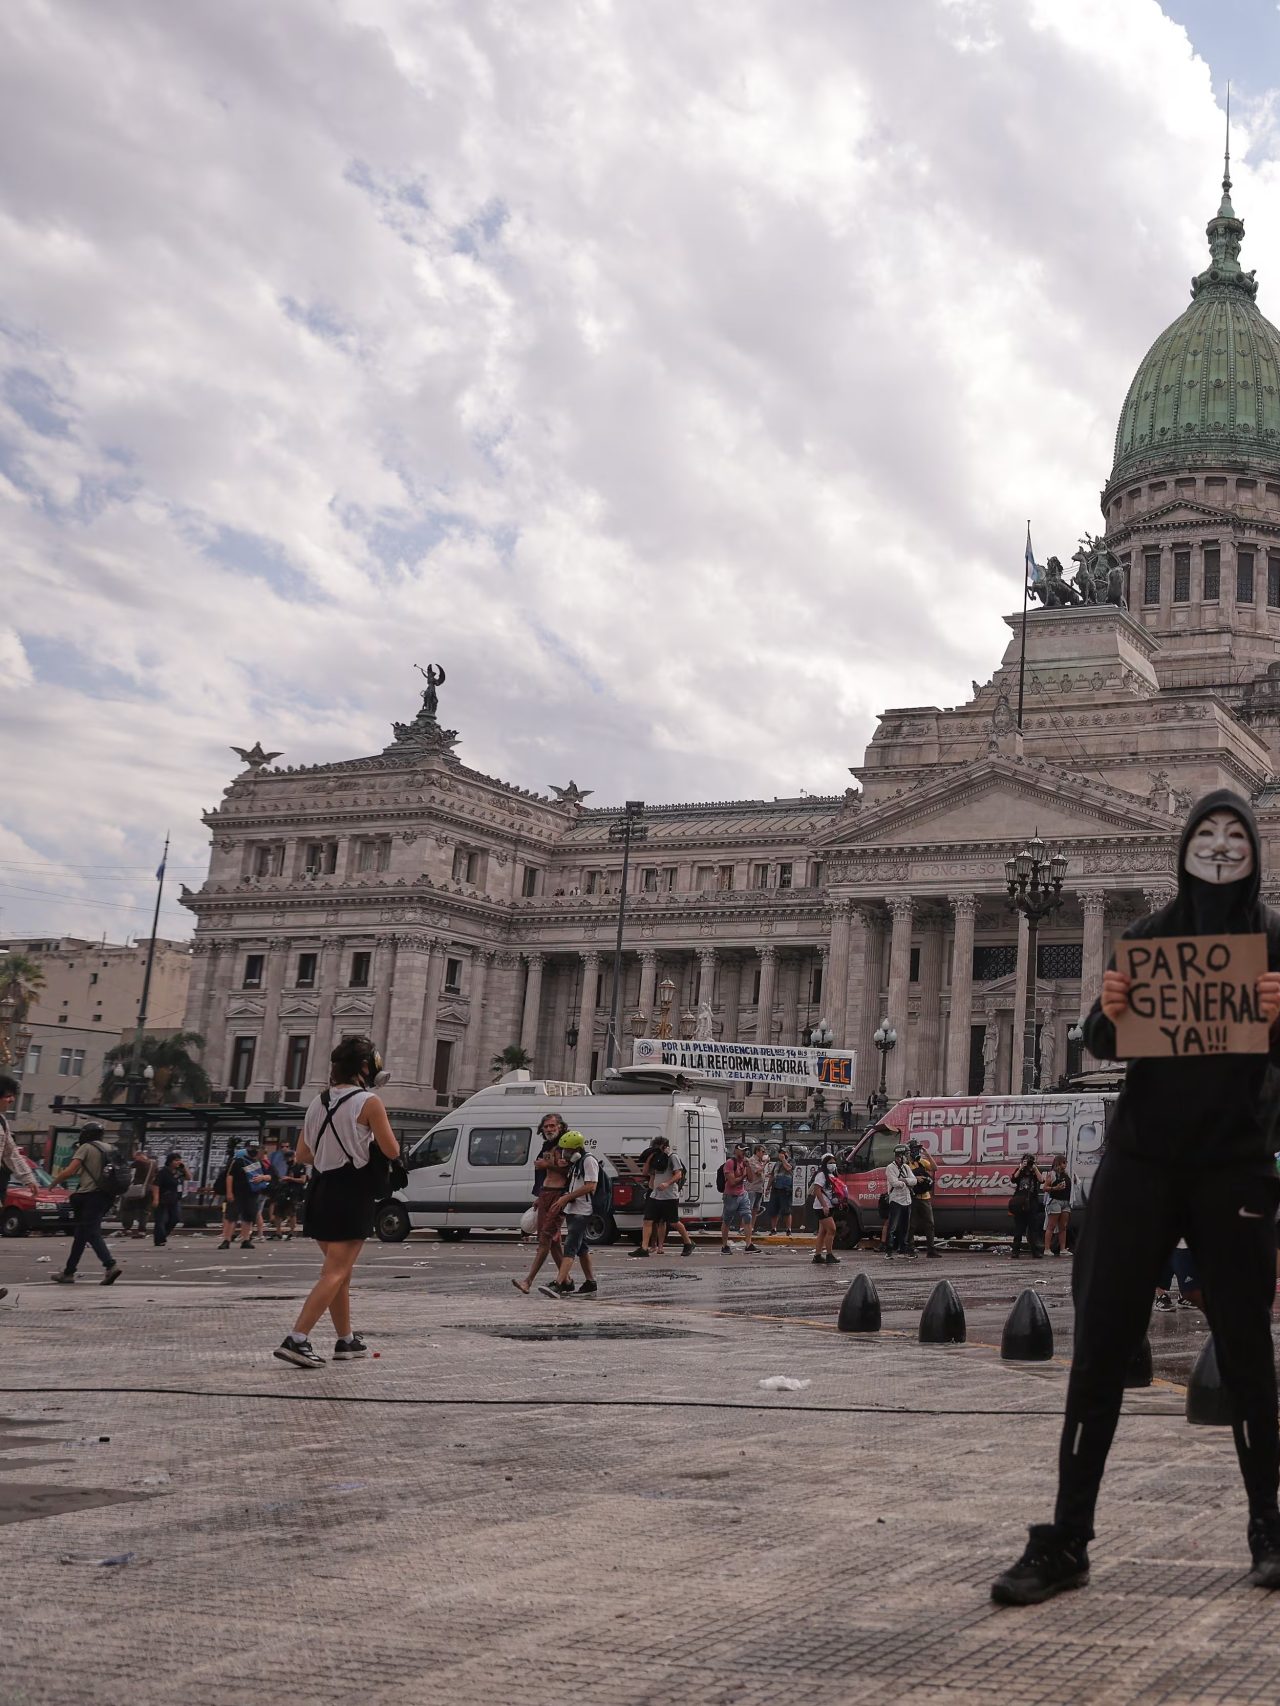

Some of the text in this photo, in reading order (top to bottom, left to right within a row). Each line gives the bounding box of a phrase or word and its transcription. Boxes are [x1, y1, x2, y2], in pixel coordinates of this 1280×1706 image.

[921, 863, 996, 877] CONGRESO
[1127, 942, 1231, 982] PARO
[1127, 982, 1269, 1024] GENERAL
[661, 1042, 678, 1051] POR
[680, 1042, 691, 1052] LA
[693, 1042, 720, 1054] PLENA
[1159, 1025, 1228, 1055] YA!!!
[661, 1053, 810, 1076] NO A LA REFORMA LABORAL
[909, 1104, 984, 1131] FIRME
[937, 1170, 1018, 1189] crónic
